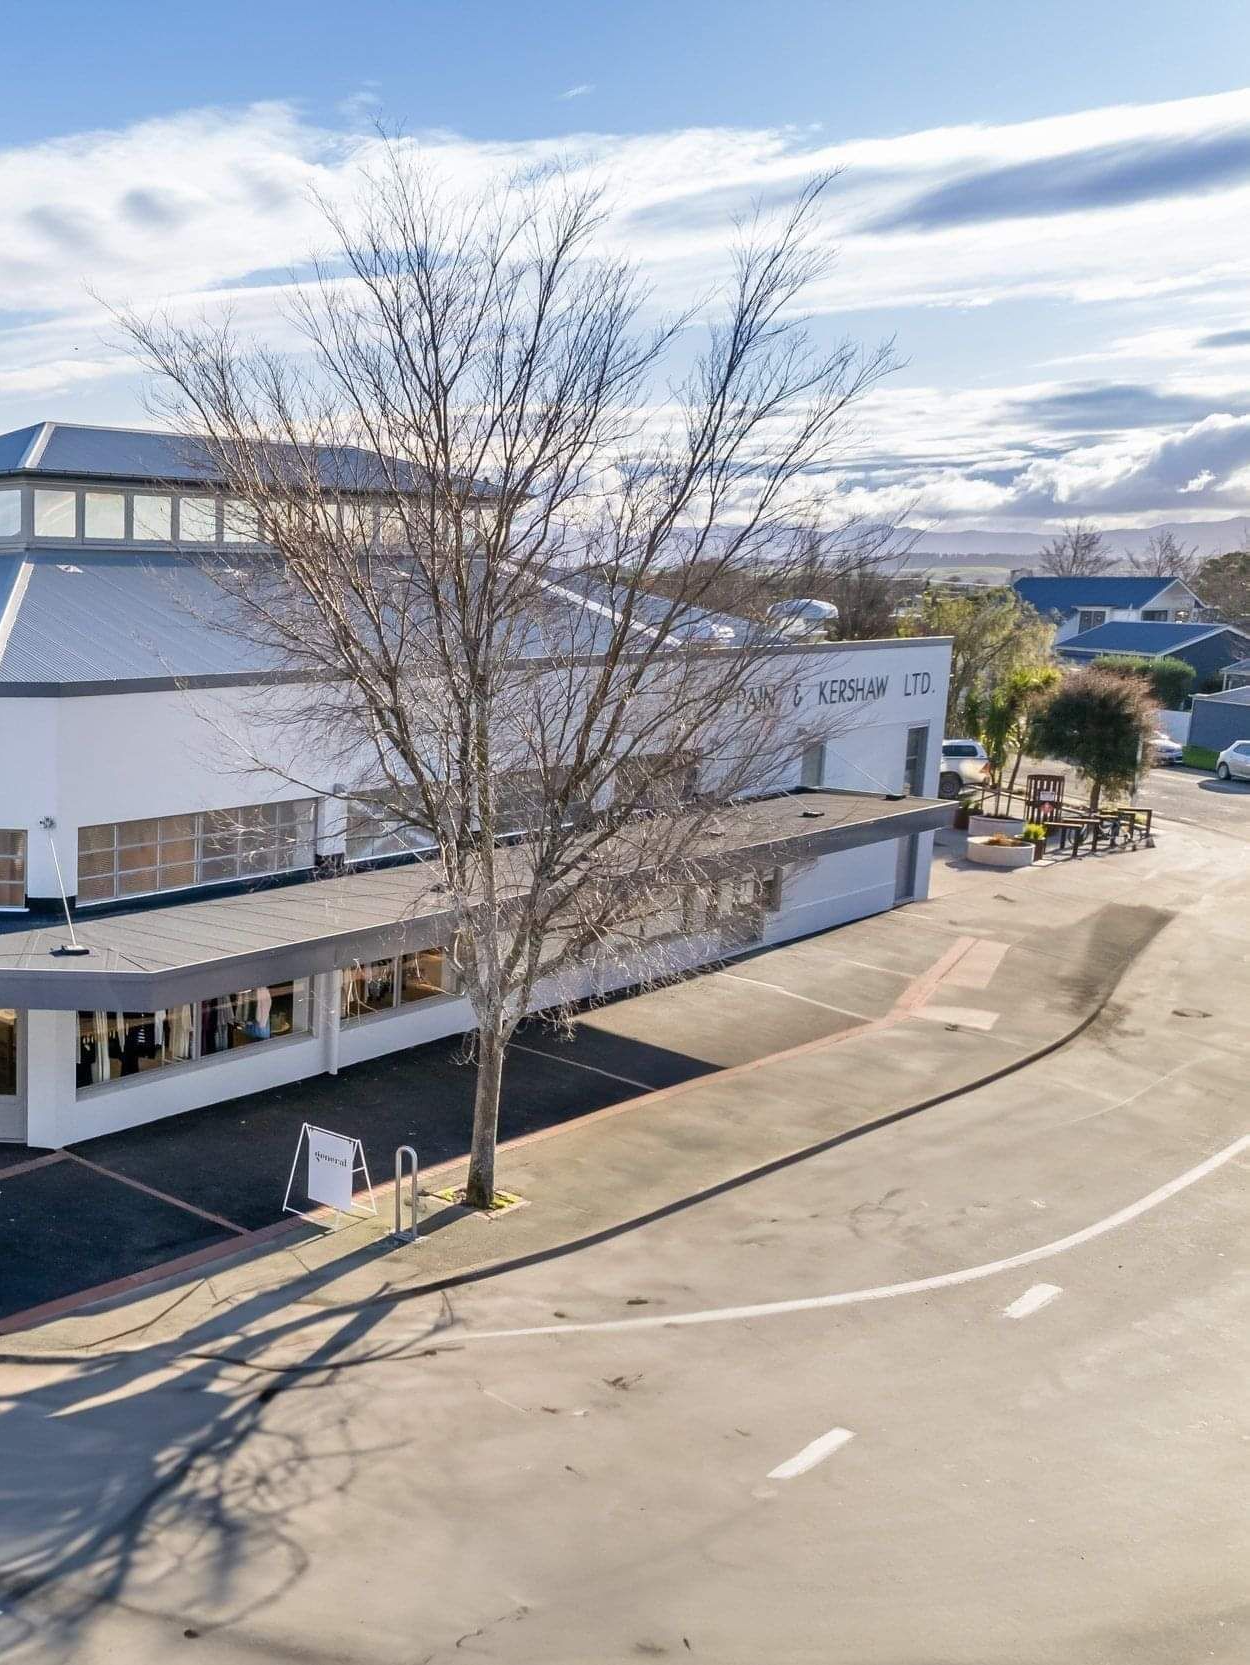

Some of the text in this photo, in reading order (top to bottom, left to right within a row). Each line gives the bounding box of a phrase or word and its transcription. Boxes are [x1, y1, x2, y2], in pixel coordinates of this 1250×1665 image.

[793, 683, 804, 708] &
[818, 675, 889, 706] KERSHAW
[903, 671, 935, 697] LTD.
[314, 1151, 348, 1168] general
